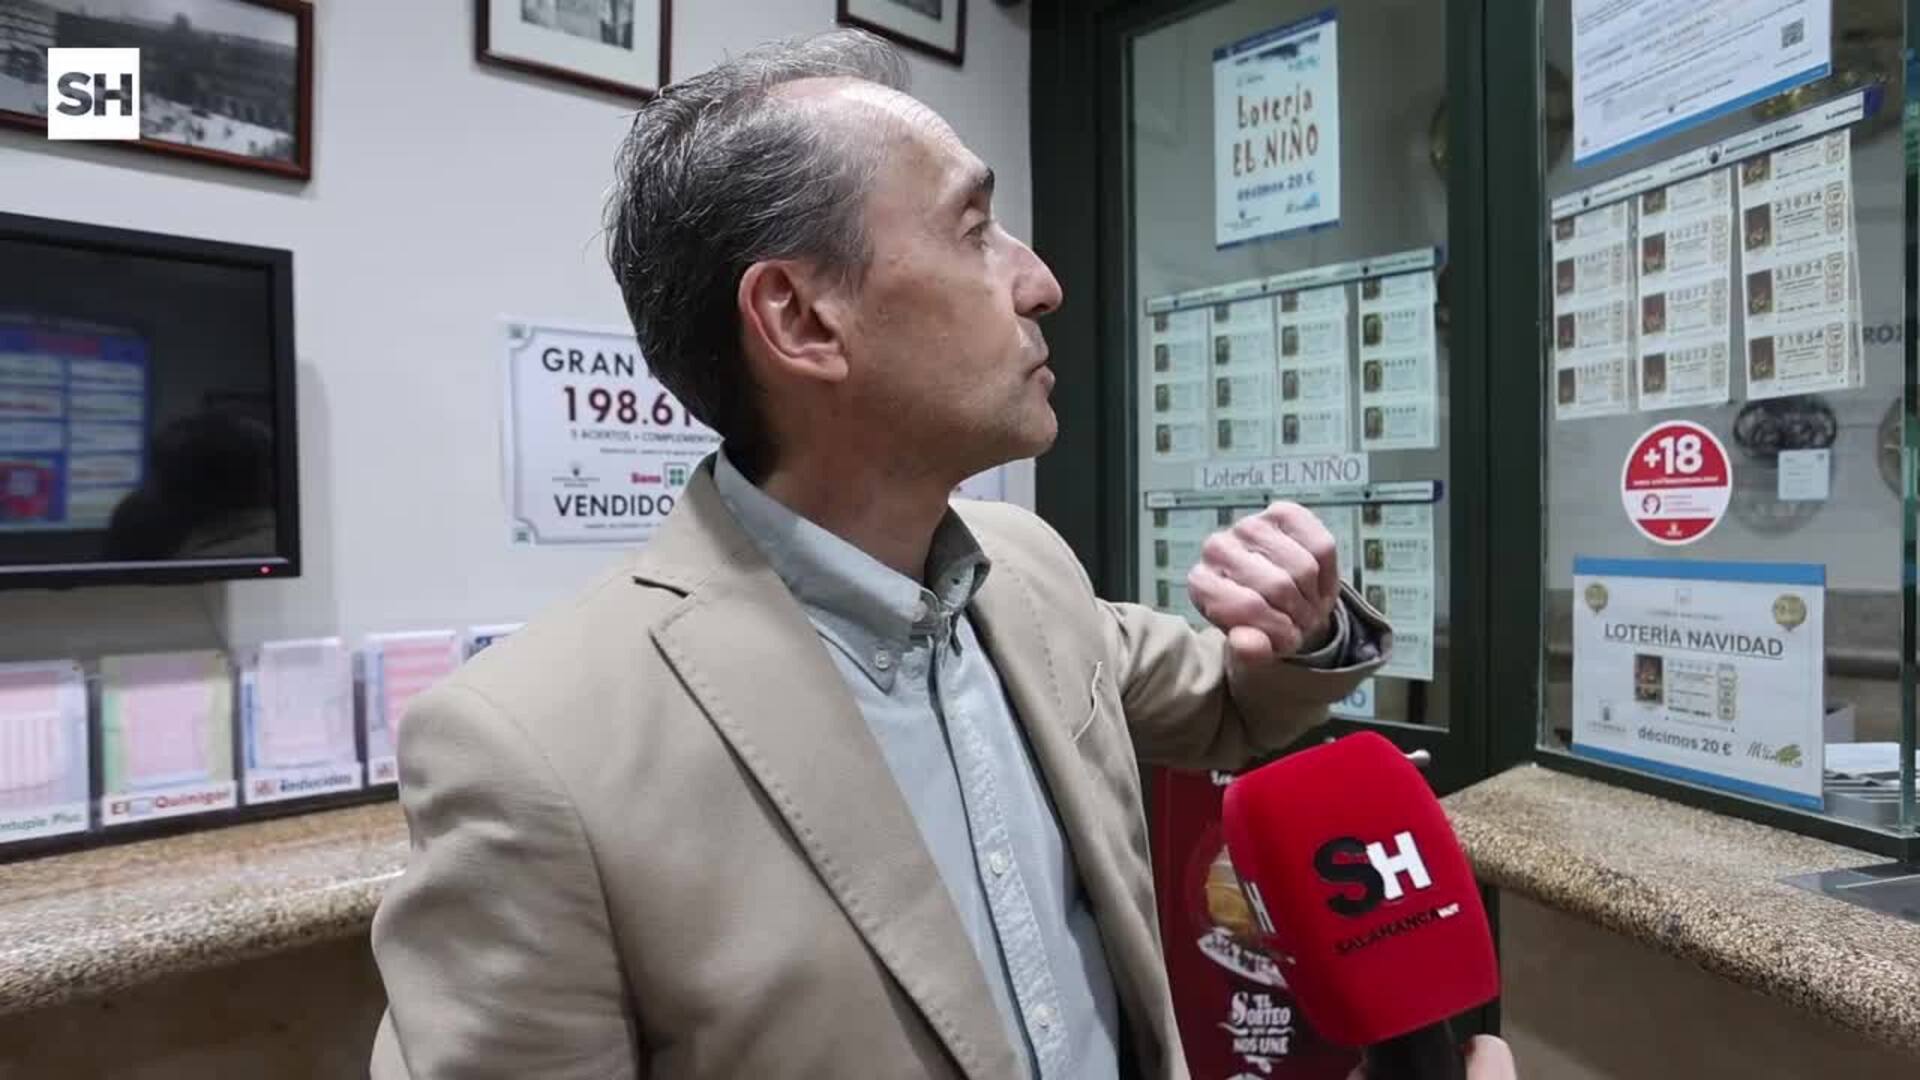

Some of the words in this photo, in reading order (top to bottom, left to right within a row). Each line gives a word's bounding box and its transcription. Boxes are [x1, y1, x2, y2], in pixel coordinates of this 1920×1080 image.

[1233, 140, 1256, 176] EL
[1264, 118, 1319, 168] NIÑO
[1287, 173, 1303, 190] 20
[542, 348, 634, 377] GRAN
[1643, 435, 1703, 475] +18
[1203, 466, 1264, 488] Lotería
[1271, 463, 1295, 483] EL
[1302, 455, 1361, 481] NIÑO
[553, 494, 675, 517] VENDIDO
[1605, 623, 1682, 646] LOTERÍA
[1687, 630, 1784, 656] NAVIDAD
[1638, 726, 1699, 750] décimos
[1701, 737, 1719, 752] 20
[1722, 742, 1732, 756] €
[1314, 831, 1432, 918] SH
[1259, 1037, 1290, 1055] UNE
